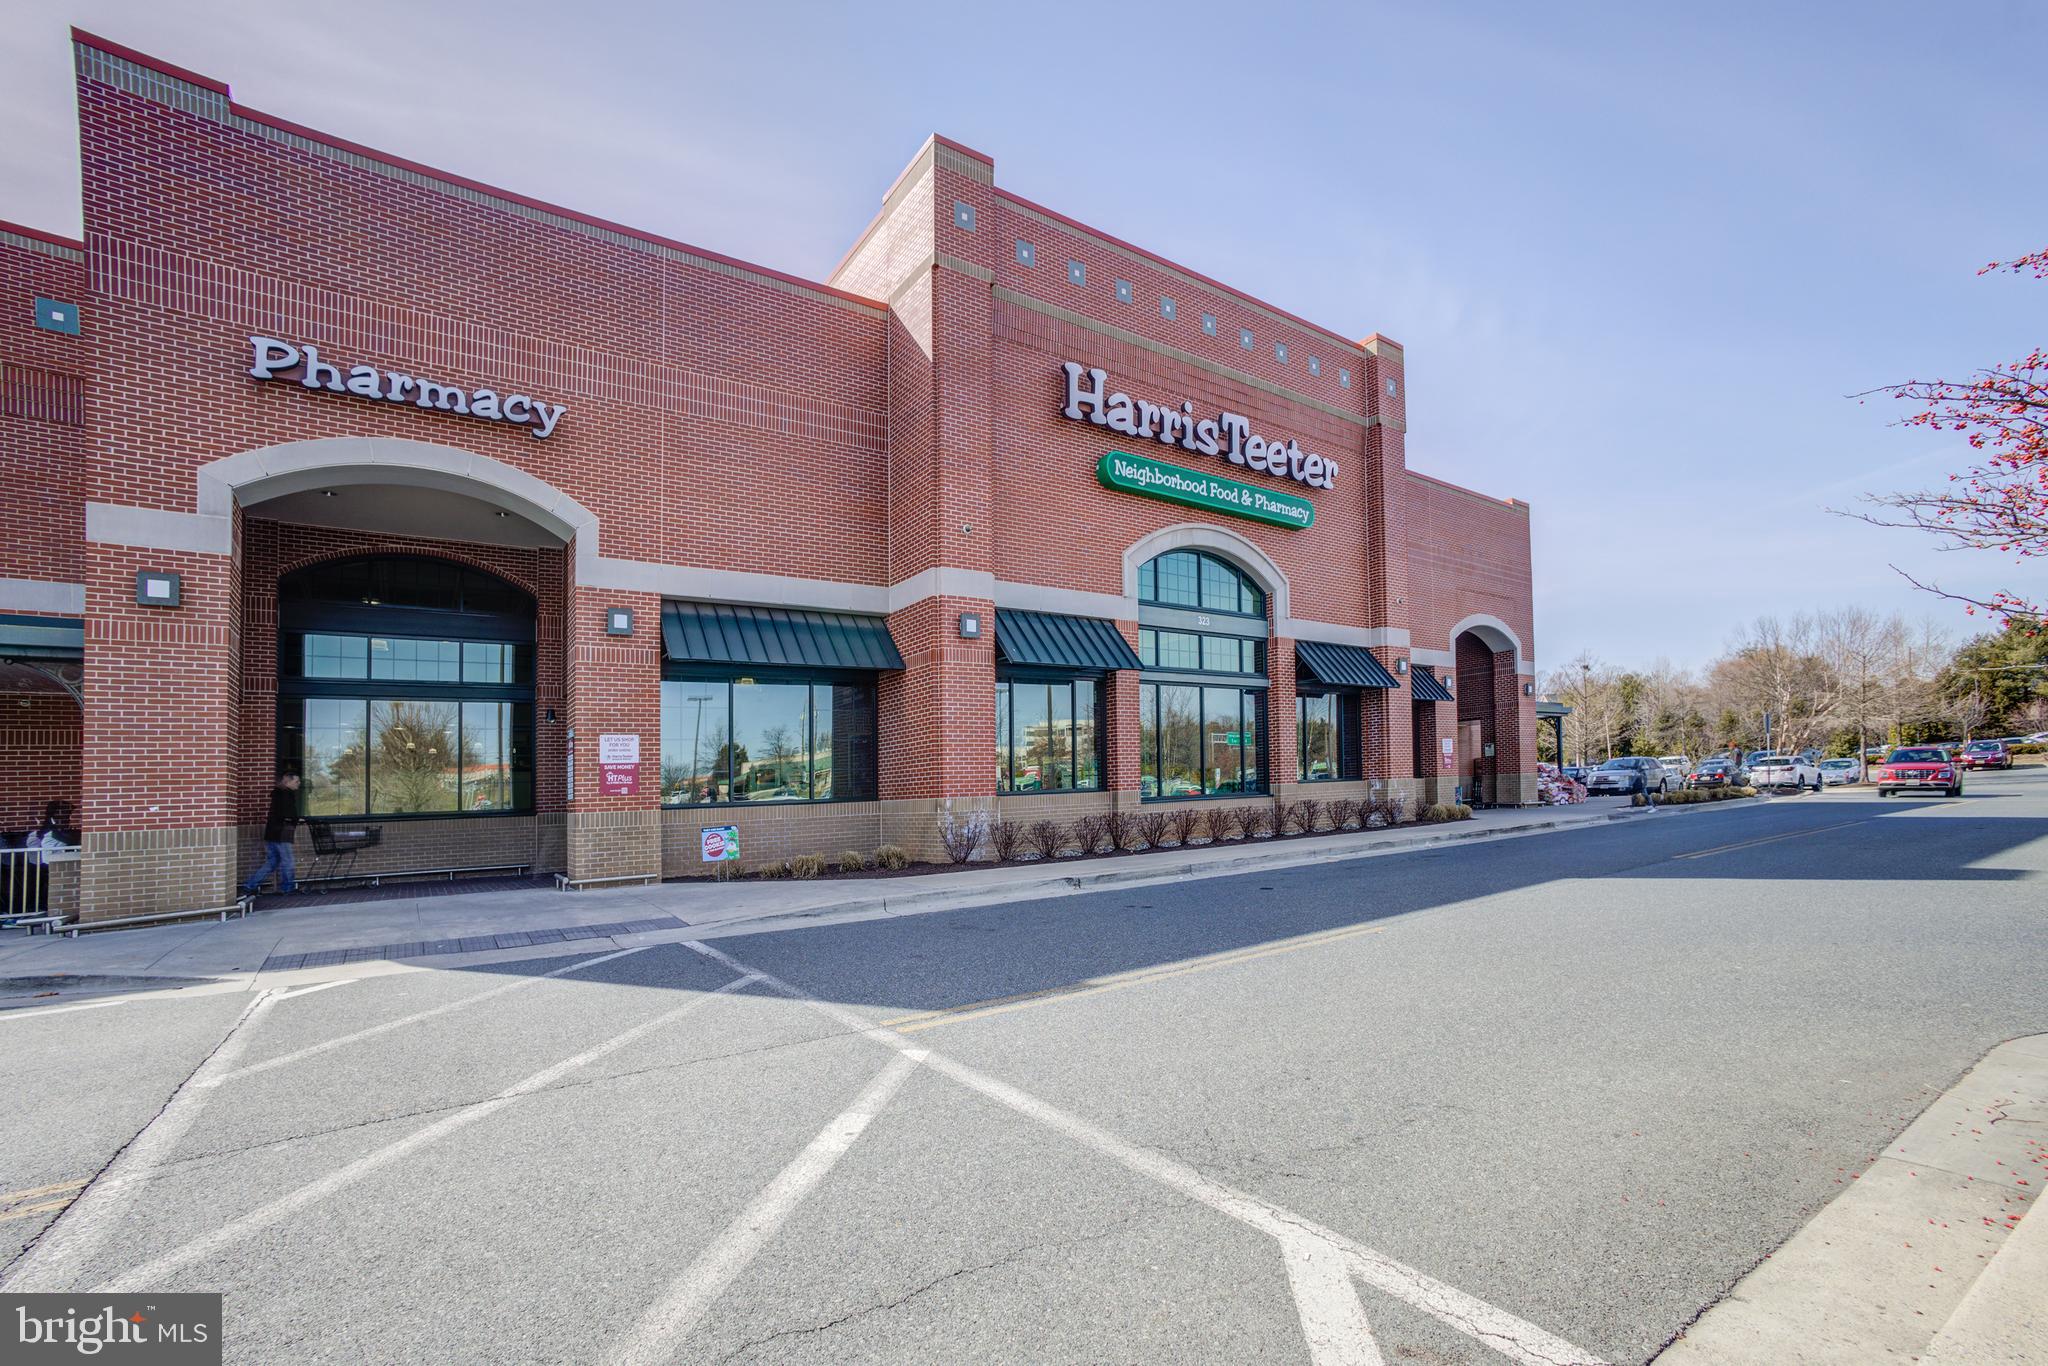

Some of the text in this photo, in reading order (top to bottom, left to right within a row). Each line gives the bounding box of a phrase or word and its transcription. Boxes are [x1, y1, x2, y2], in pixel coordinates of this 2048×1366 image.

[249, 335, 567, 439] Pharmacy
[1114, 458, 1310, 523] Neighborhood Food & Pharmacy
[1198, 615, 1210, 626] 323
